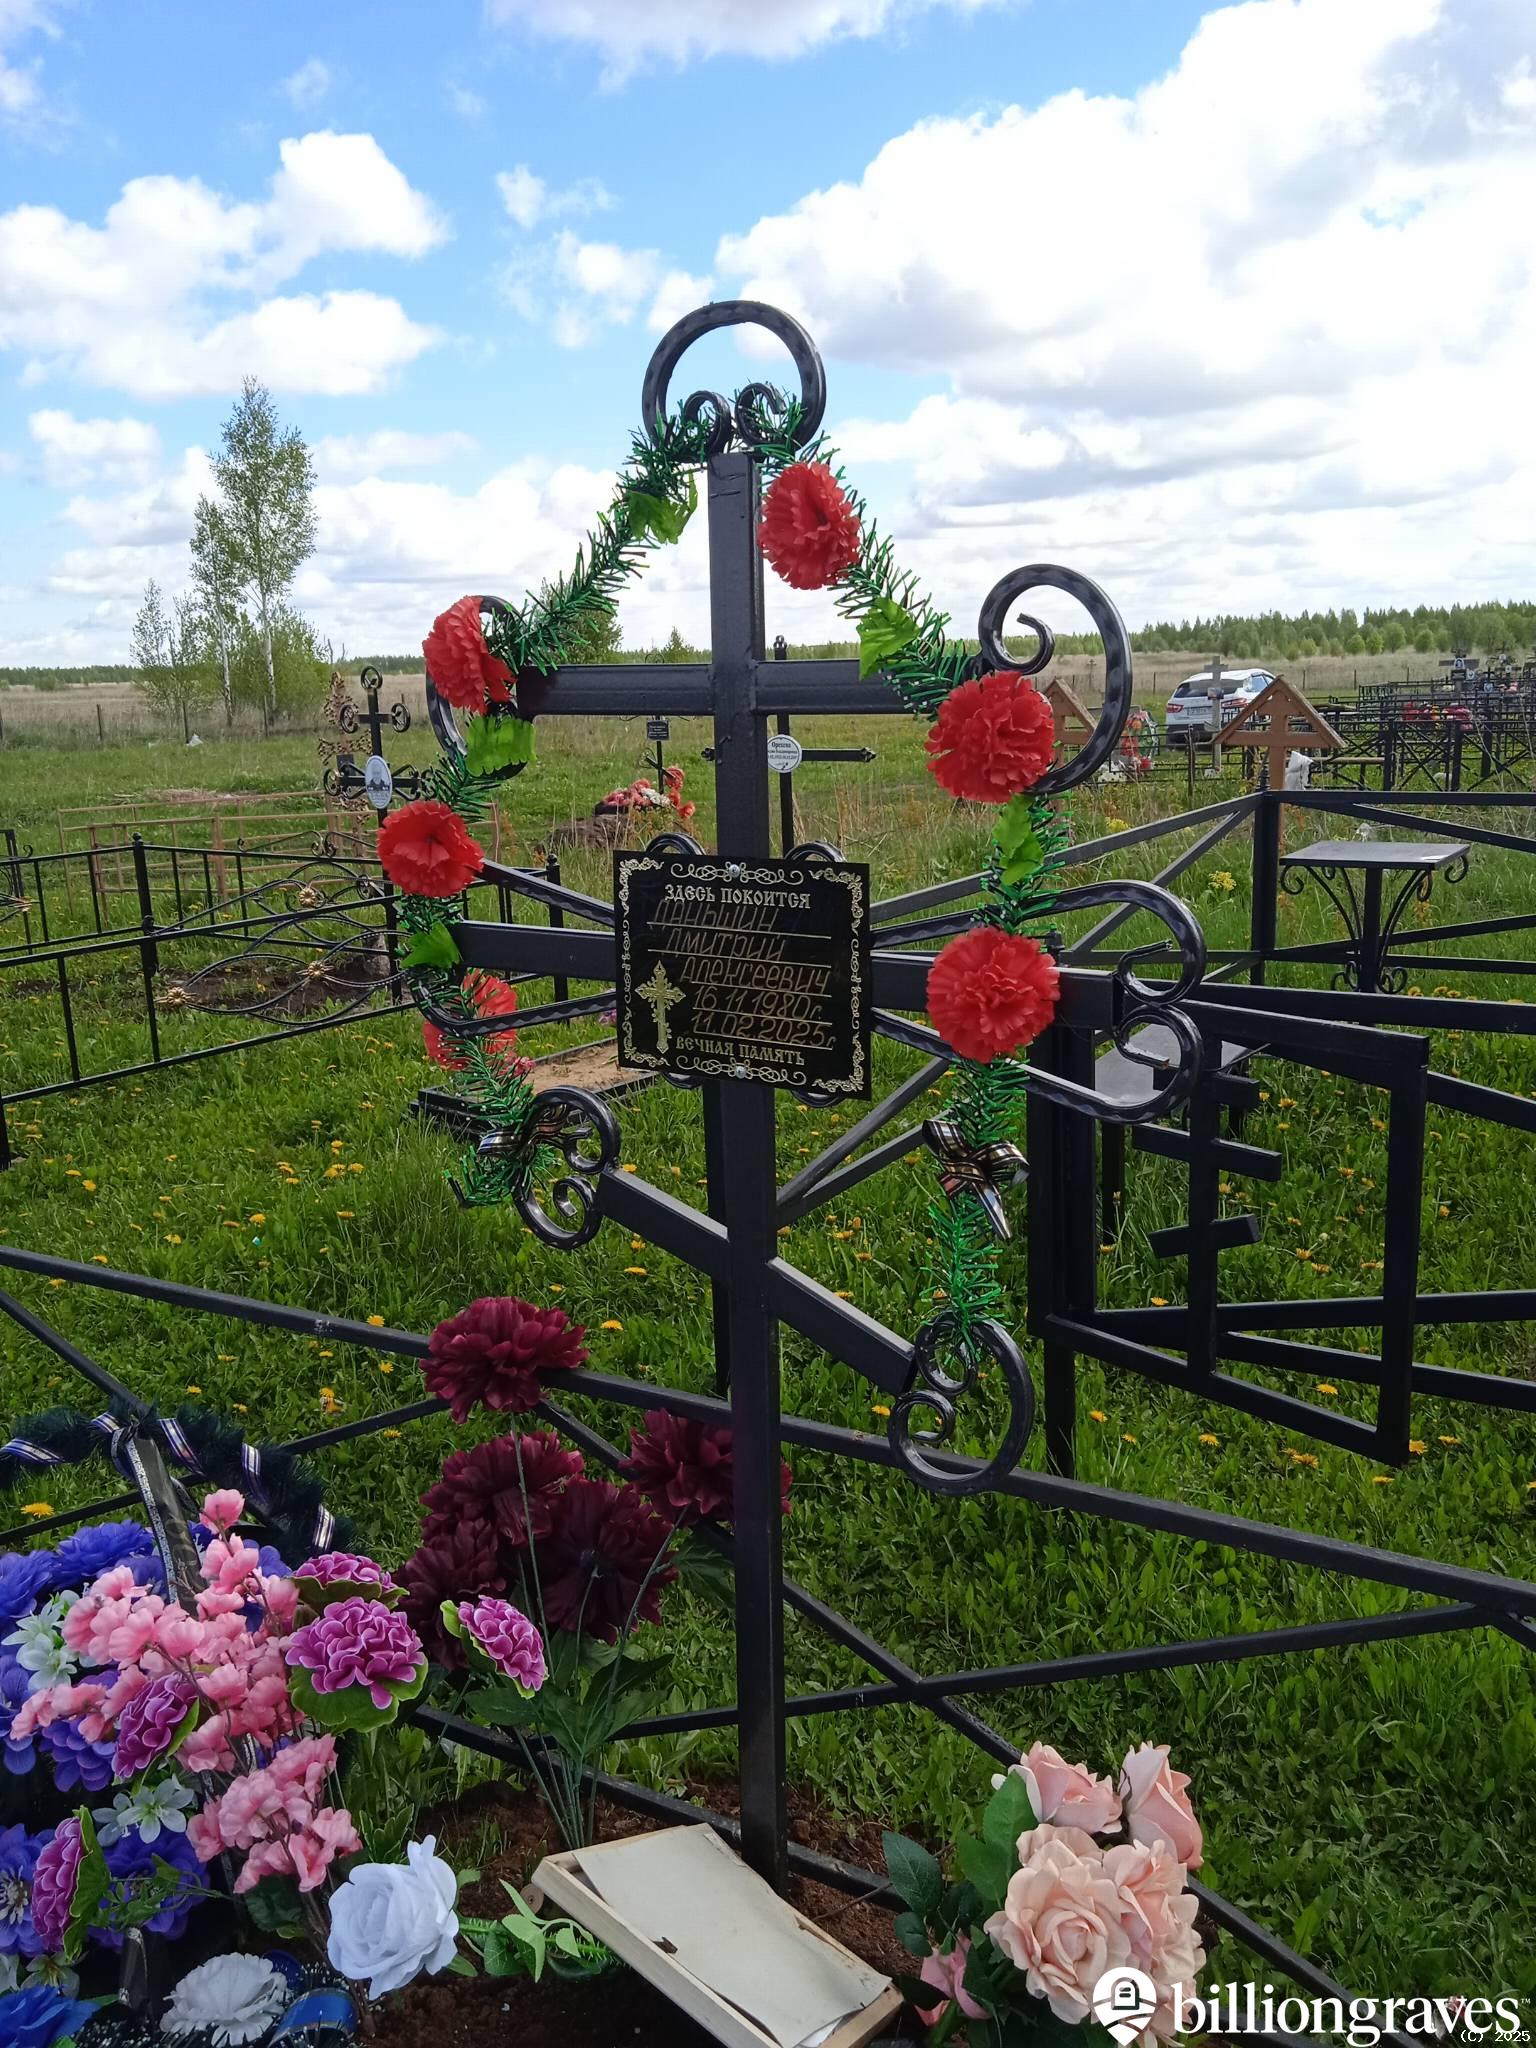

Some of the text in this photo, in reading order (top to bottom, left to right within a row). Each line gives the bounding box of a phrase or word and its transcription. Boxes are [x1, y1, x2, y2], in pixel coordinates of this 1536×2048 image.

[664, 883, 811, 909] ЗДЕСЬ ПОКОИТСЯ
[675, 1035, 806, 1066] ВЕЧНАЯ ПАМЯТЬ
